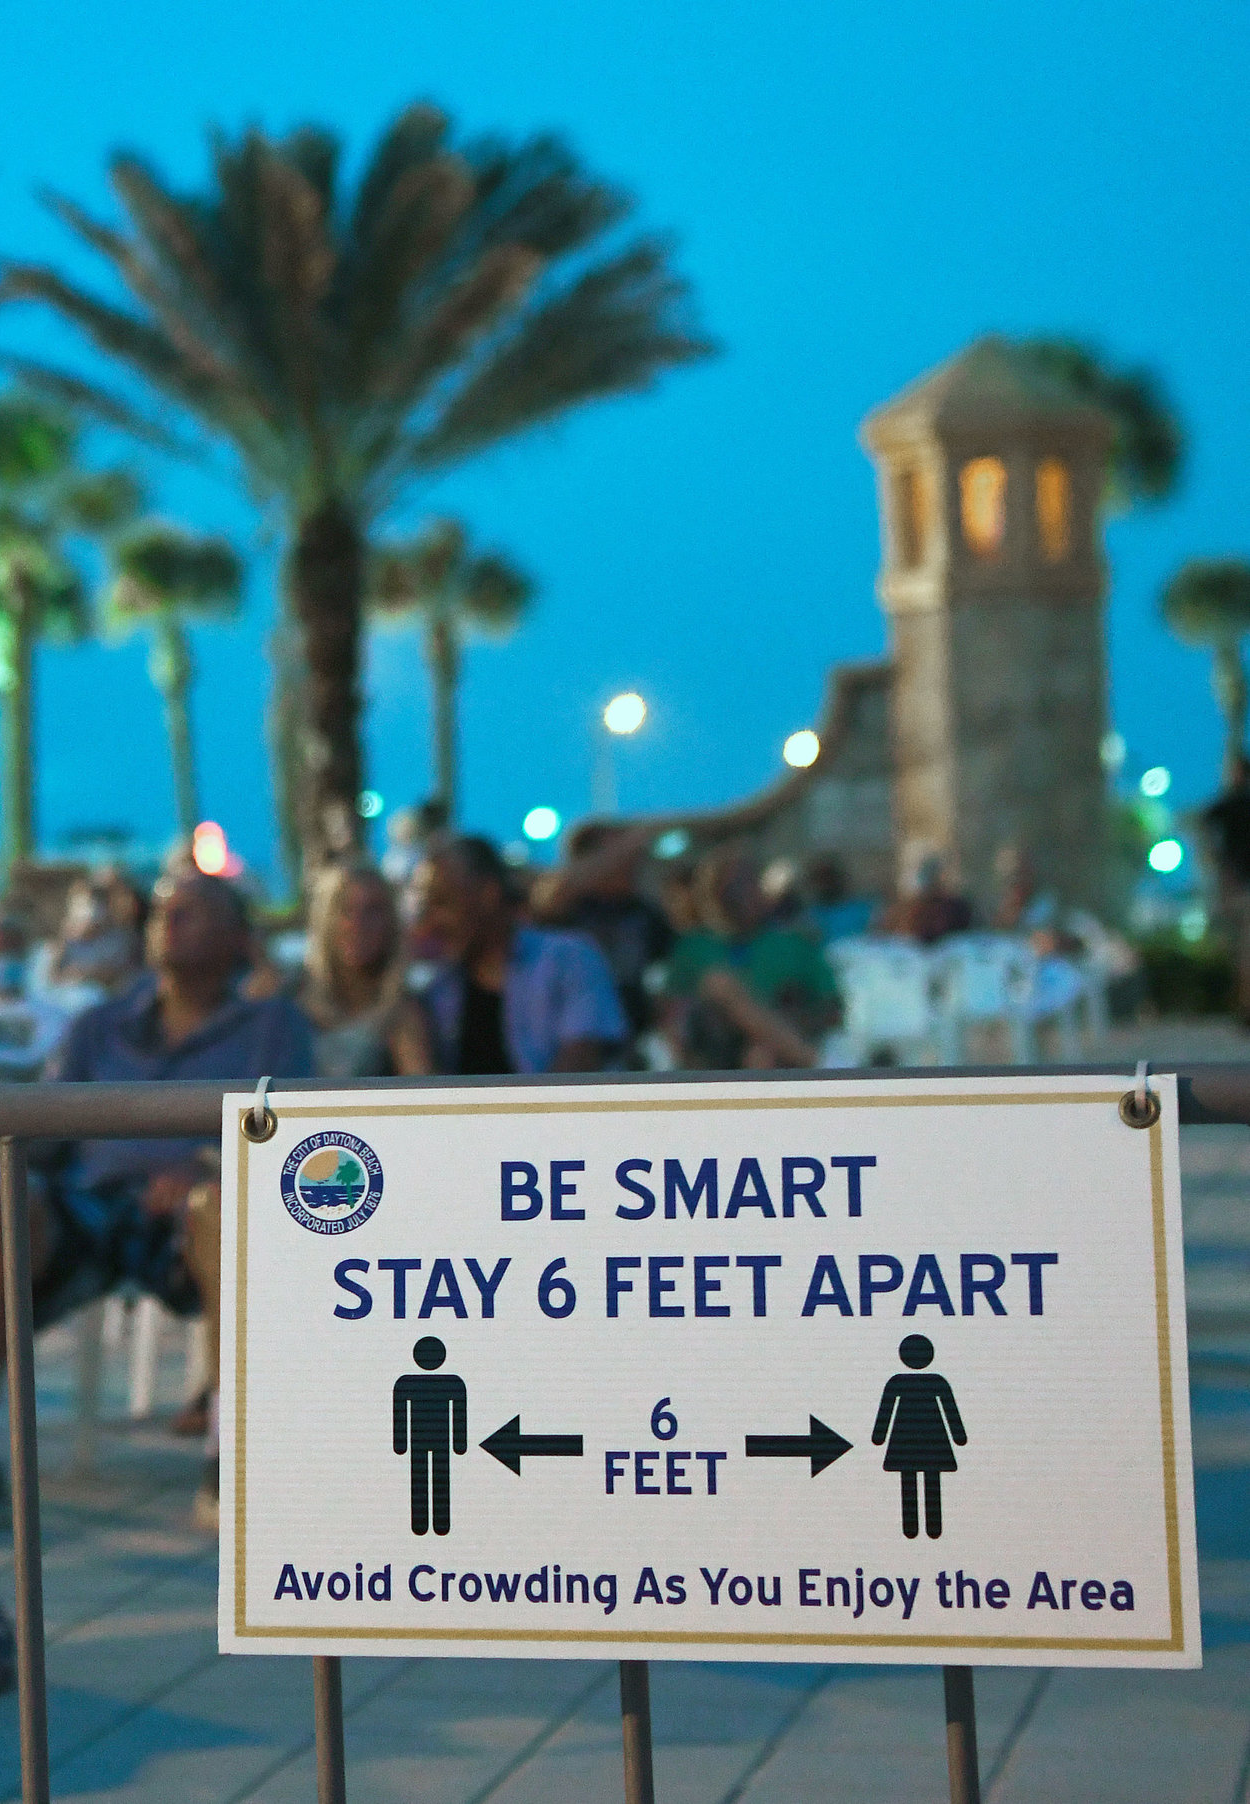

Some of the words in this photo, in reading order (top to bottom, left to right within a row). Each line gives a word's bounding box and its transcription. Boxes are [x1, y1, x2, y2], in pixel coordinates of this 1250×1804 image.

[283, 1158, 299, 1176] THE
[293, 1141, 311, 1161] CITY
[310, 1135, 323, 1148] OF
[323, 1133, 362, 1153] DAYTONA
[359, 1146, 382, 1176] BEACH
[500, 1159, 586, 1222] BE
[615, 1155, 877, 1221] SMART
[283, 1192, 345, 1234] INCORPORATED
[347, 1209, 368, 1230] JULY
[364, 1191, 381, 1212] 1876
[333, 1257, 513, 1321] STAY
[537, 1256, 577, 1320] 6
[605, 1254, 782, 1318] FEET
[800, 1252, 1059, 1317] APART
[650, 1396, 679, 1441] 6
[604, 1451, 728, 1496] FEET
[273, 1562, 392, 1602] Avoid
[408, 1564, 618, 1616] Crowding
[632, 1566, 687, 1605] As
[699, 1567, 782, 1607] You
[798, 1567, 921, 1620] Enjoy
[935, 1569, 1011, 1610] the
[1026, 1571, 1135, 1612] Area
